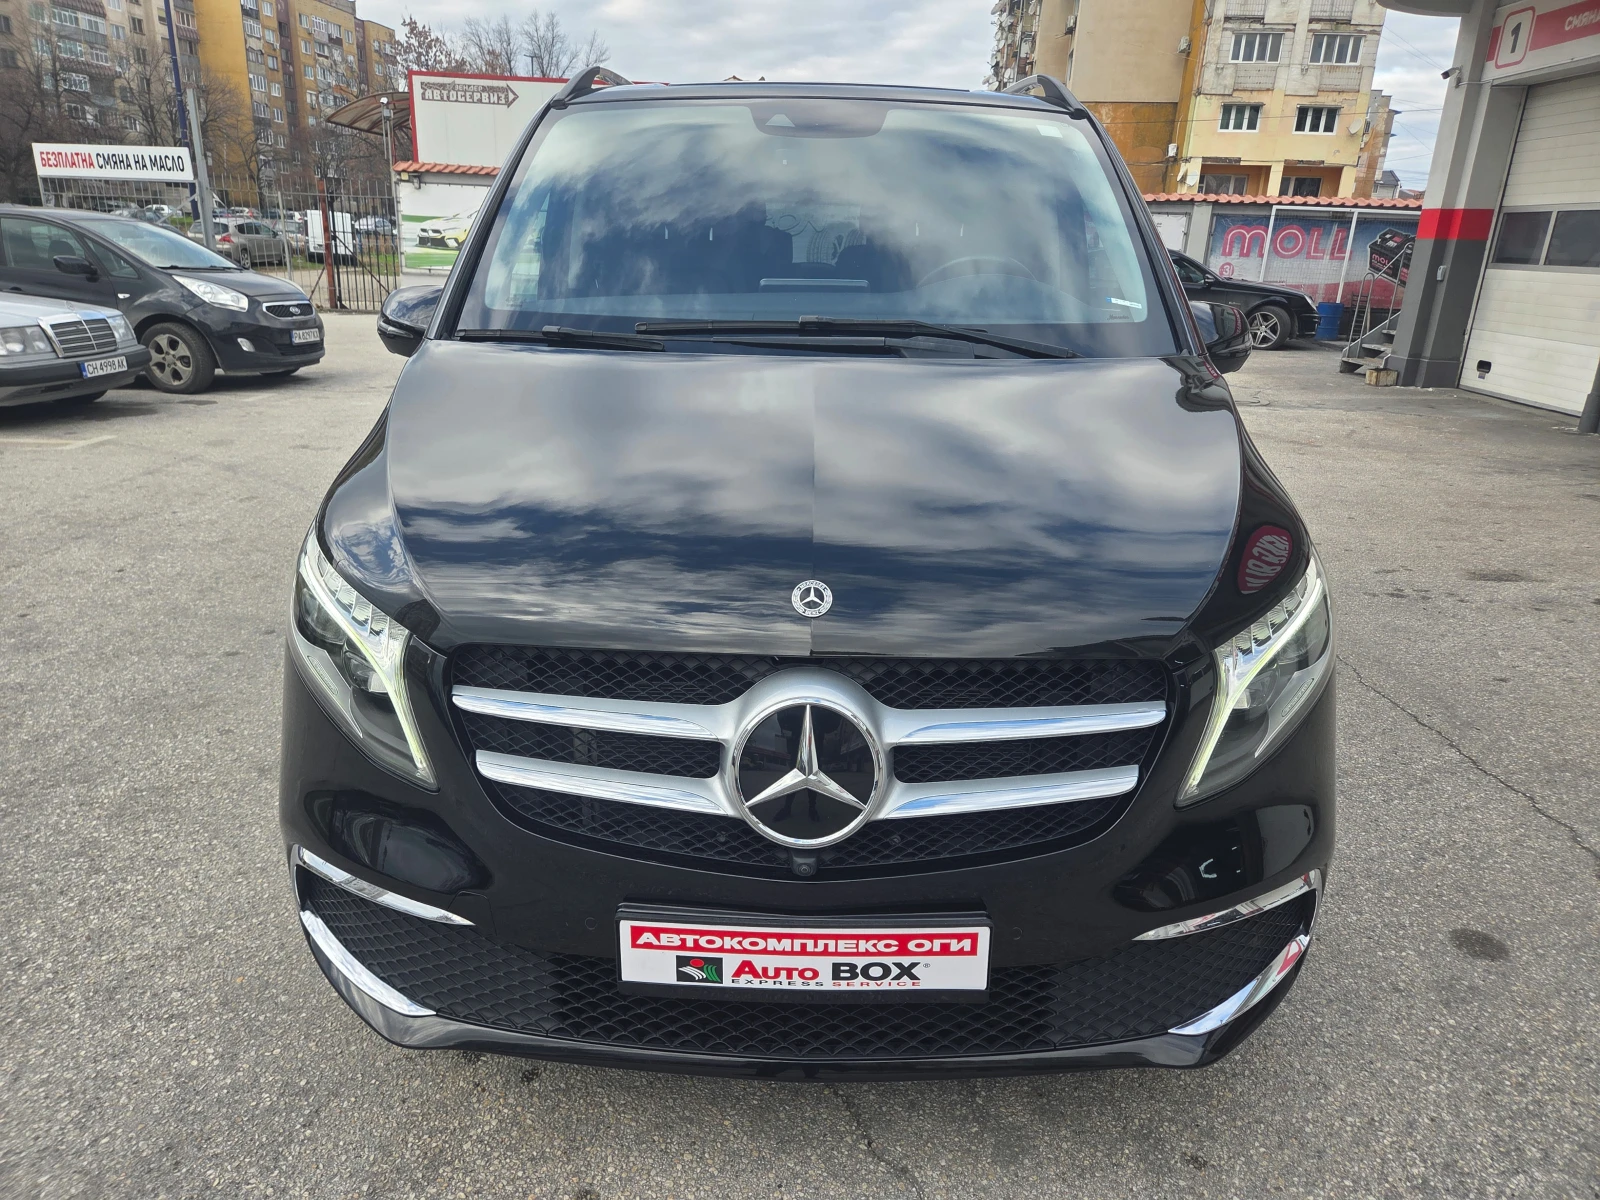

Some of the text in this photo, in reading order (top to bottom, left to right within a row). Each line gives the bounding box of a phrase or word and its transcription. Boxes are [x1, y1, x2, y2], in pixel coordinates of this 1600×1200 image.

[1564, 8, 1600, 31] СМЯН
[1510, 22, 1522, 54] 1
[424, 89, 506, 104] АВТОСЕРВИЗ
[39, 151, 185, 172] БЕЗПЛАТНА СМЯНА НА МАСЛО
[86, 362, 99, 375] CH
[99, 359, 117, 373] 4998
[636, 932, 972, 952] АВТОКОМПЛЕКС ОГИ
[731, 979, 824, 987] EXPRESS
